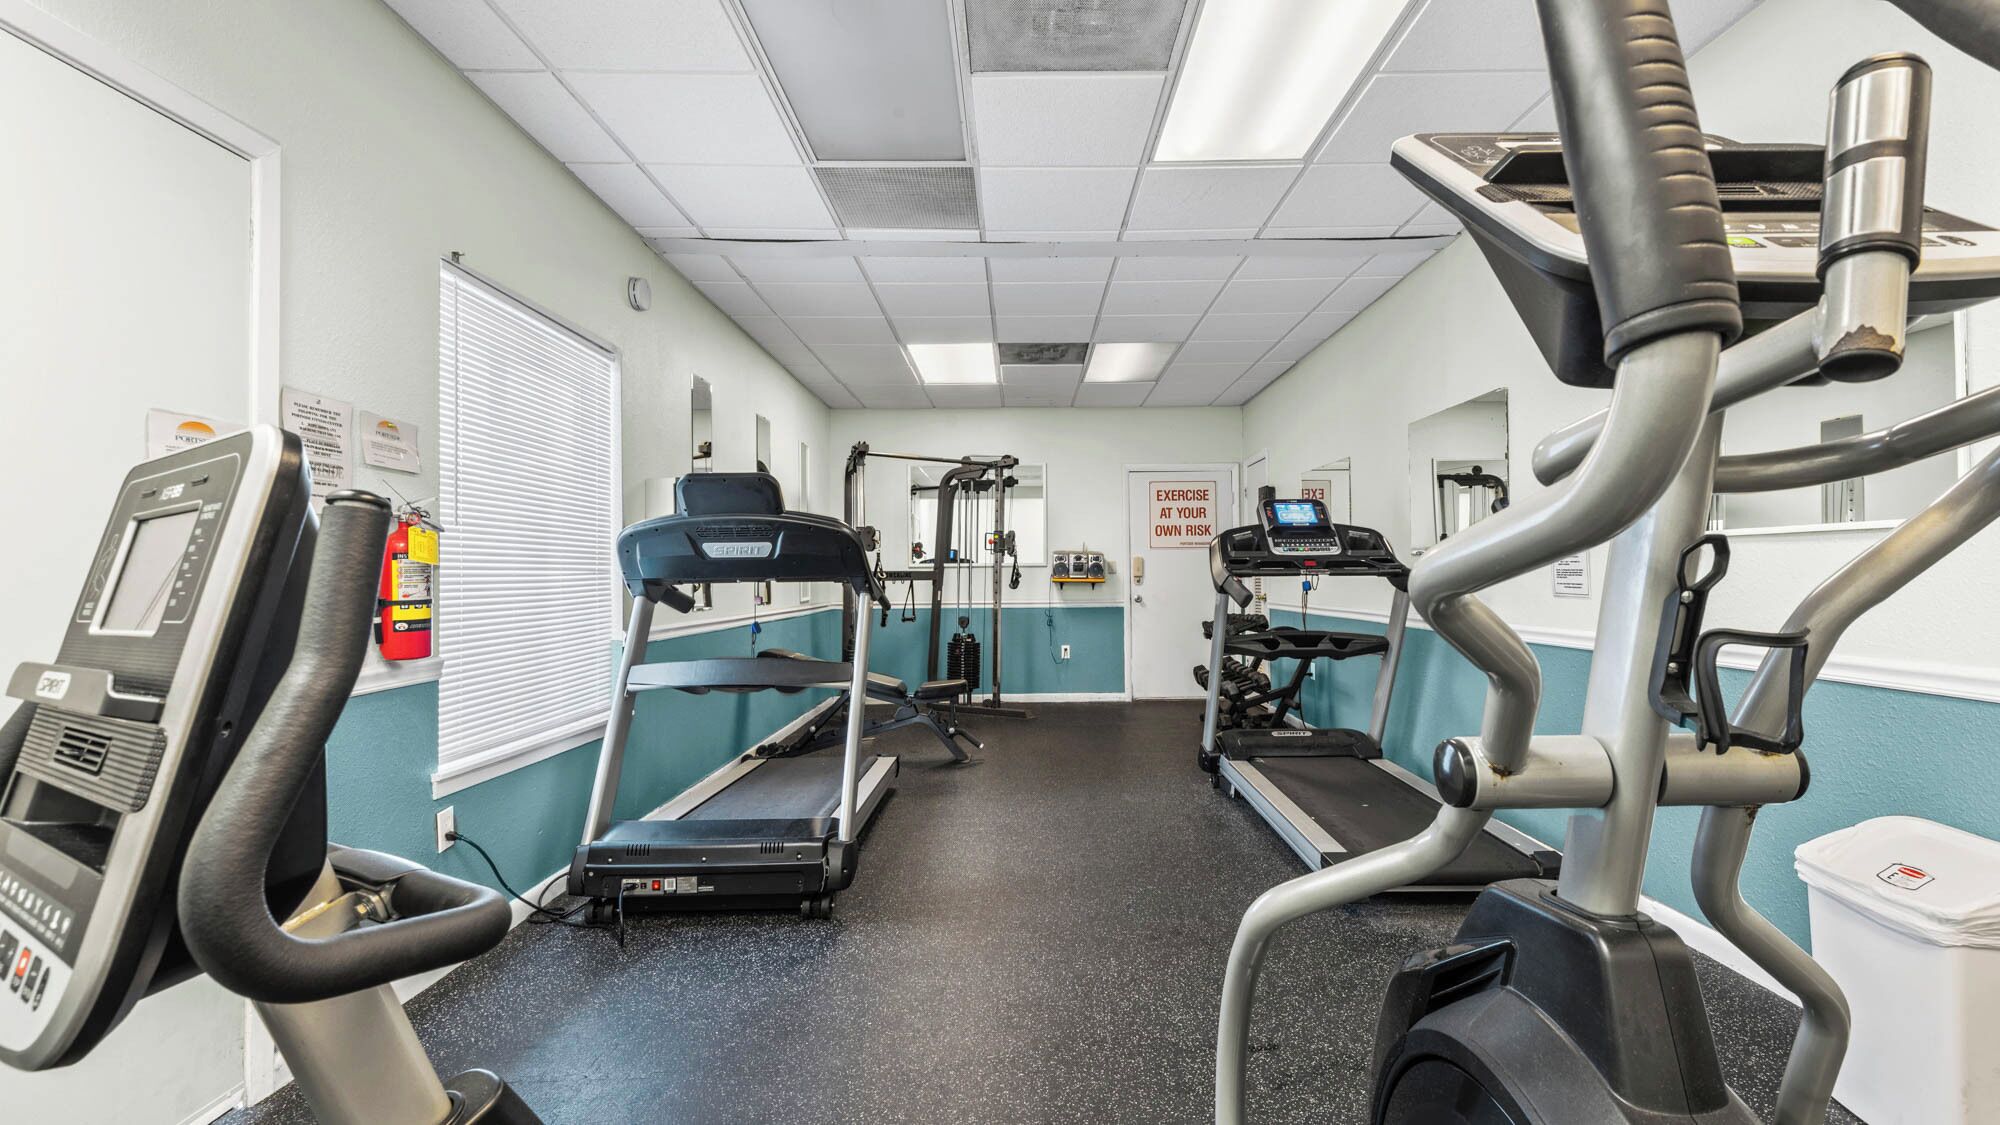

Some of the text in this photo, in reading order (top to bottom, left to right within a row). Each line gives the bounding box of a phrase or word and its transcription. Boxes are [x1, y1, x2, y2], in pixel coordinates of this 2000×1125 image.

[1156, 489, 1209, 501] EXERCISE
[1160, 507, 1207, 519] AT YOUR
[1155, 525, 1211, 536] OWN RISK
[713, 545, 763, 555] SPIRIT
